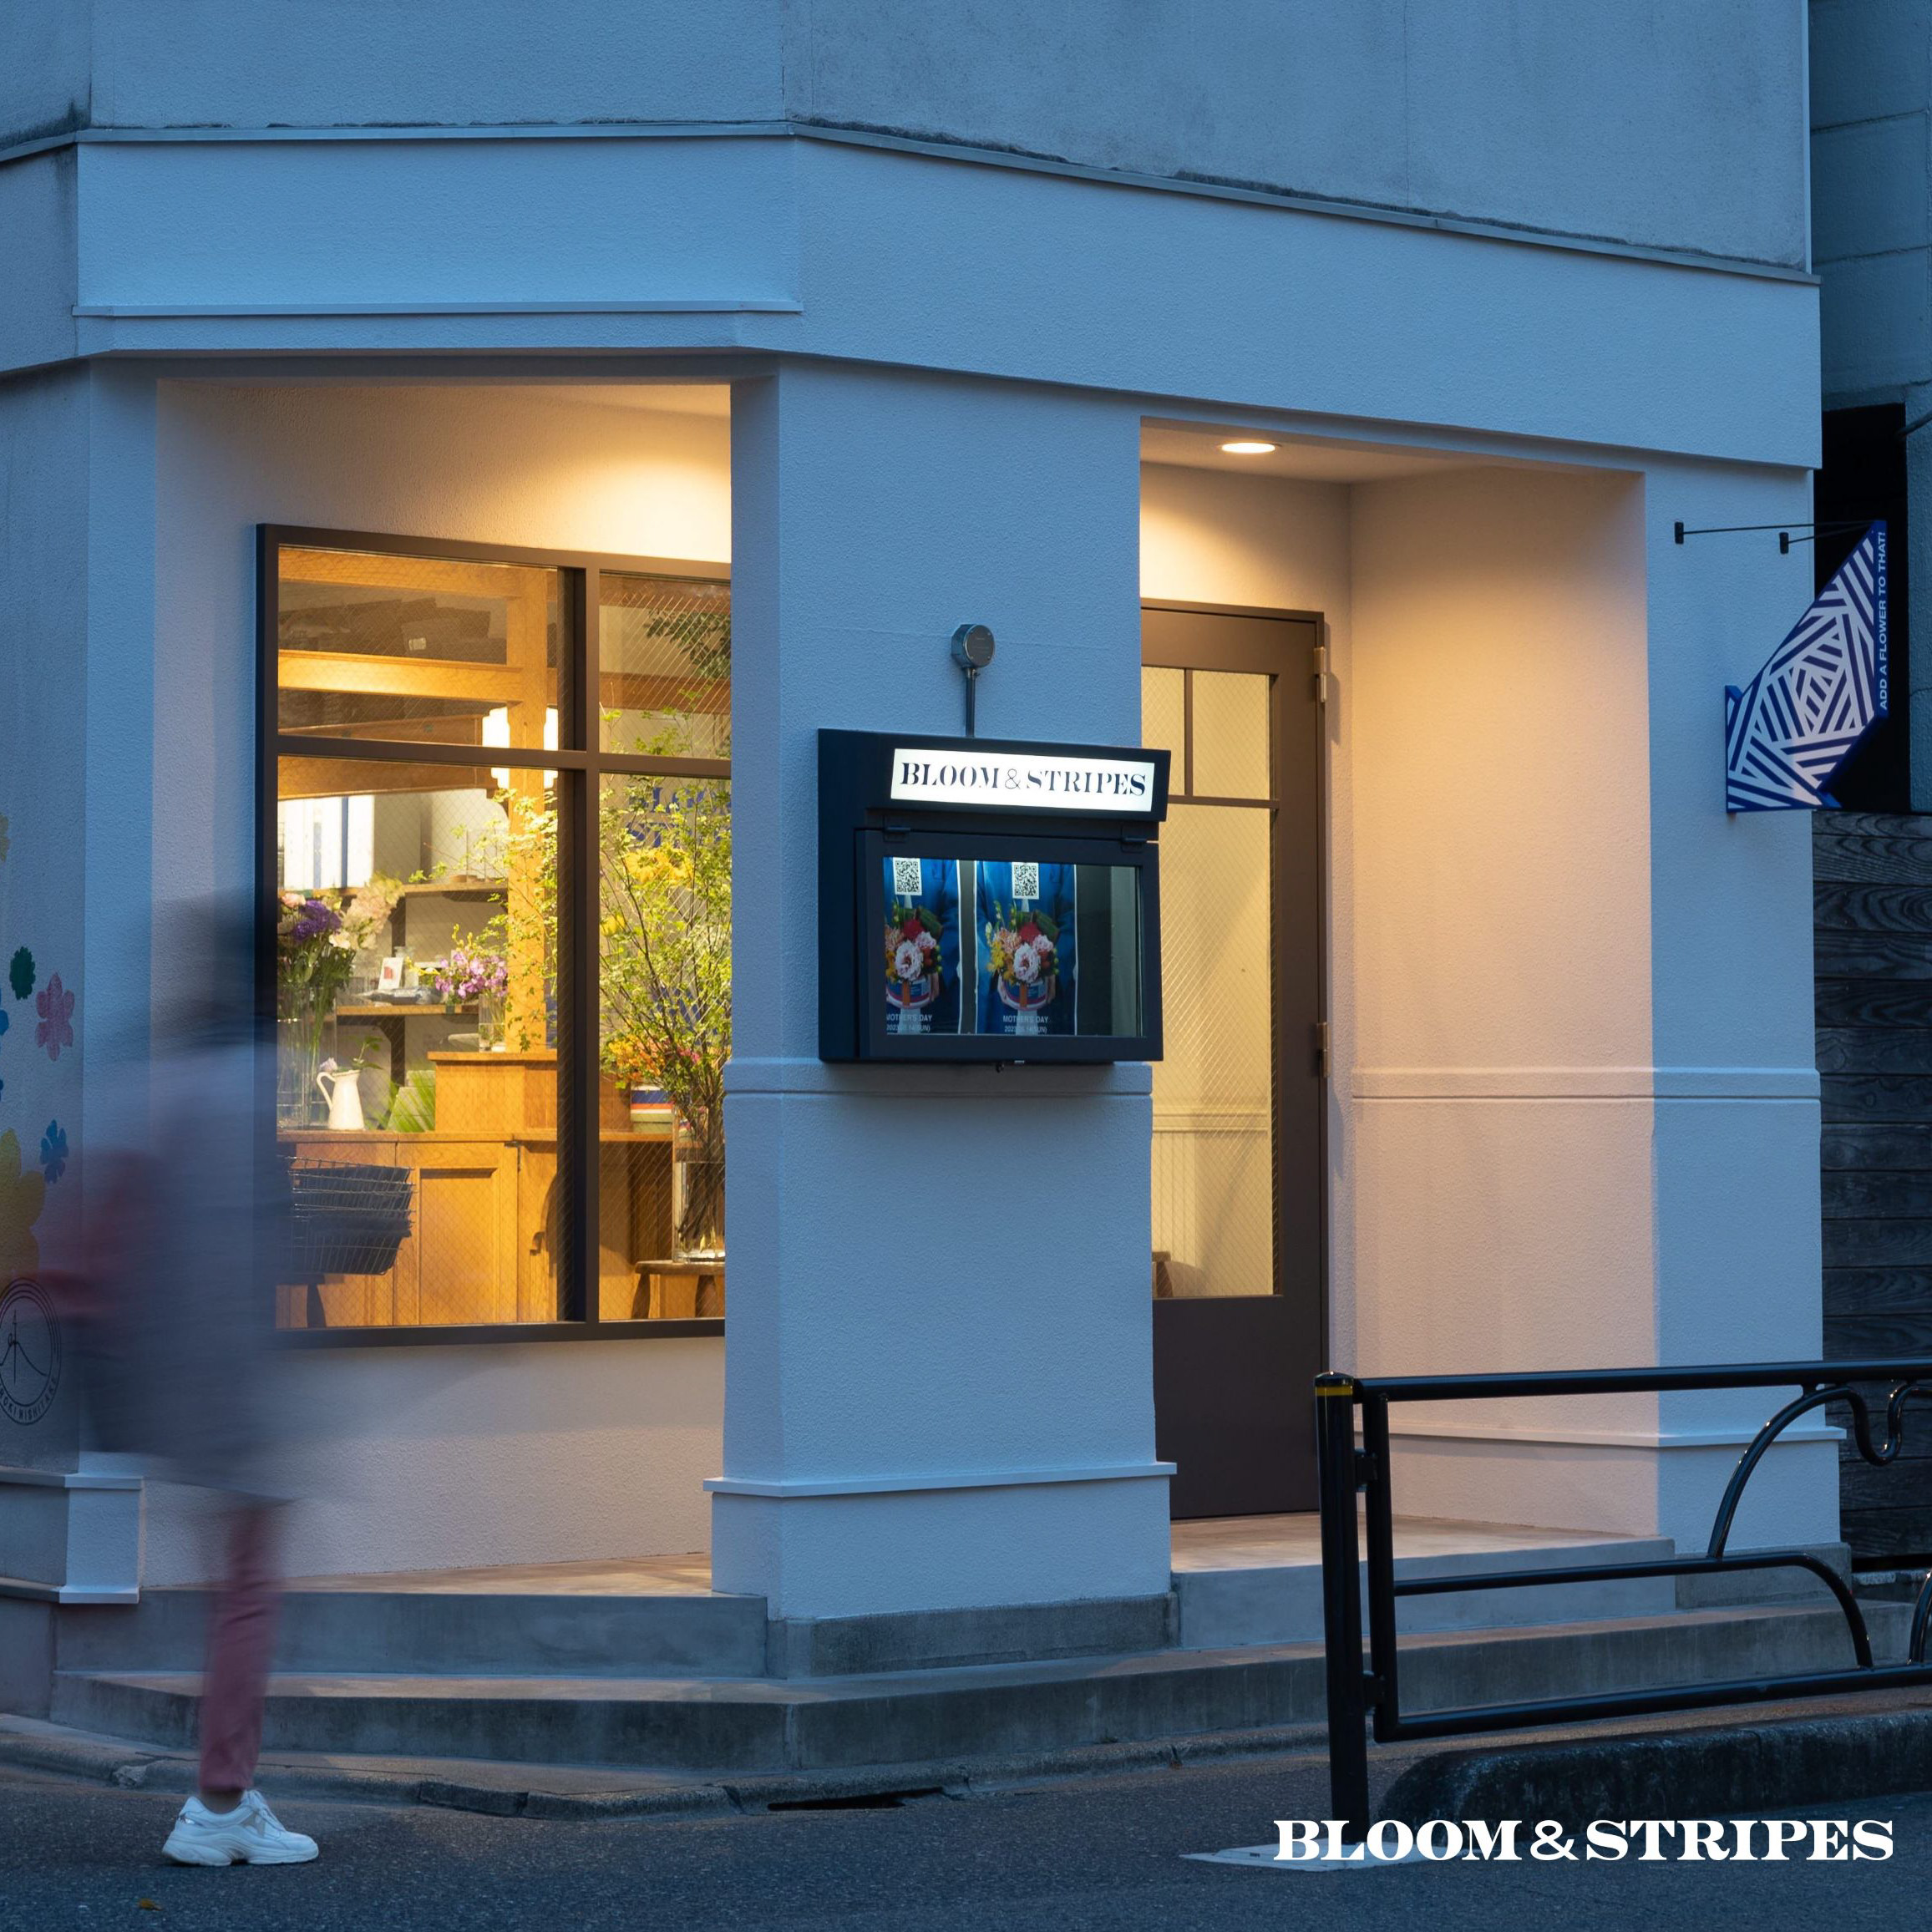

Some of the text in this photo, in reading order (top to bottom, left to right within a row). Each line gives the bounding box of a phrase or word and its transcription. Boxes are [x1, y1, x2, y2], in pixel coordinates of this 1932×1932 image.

[1878, 531, 1888, 710] ADD A FLOWER TO THAT!
[919, 1014, 933, 1022] DAY
[1036, 1016, 1049, 1024] DAY
